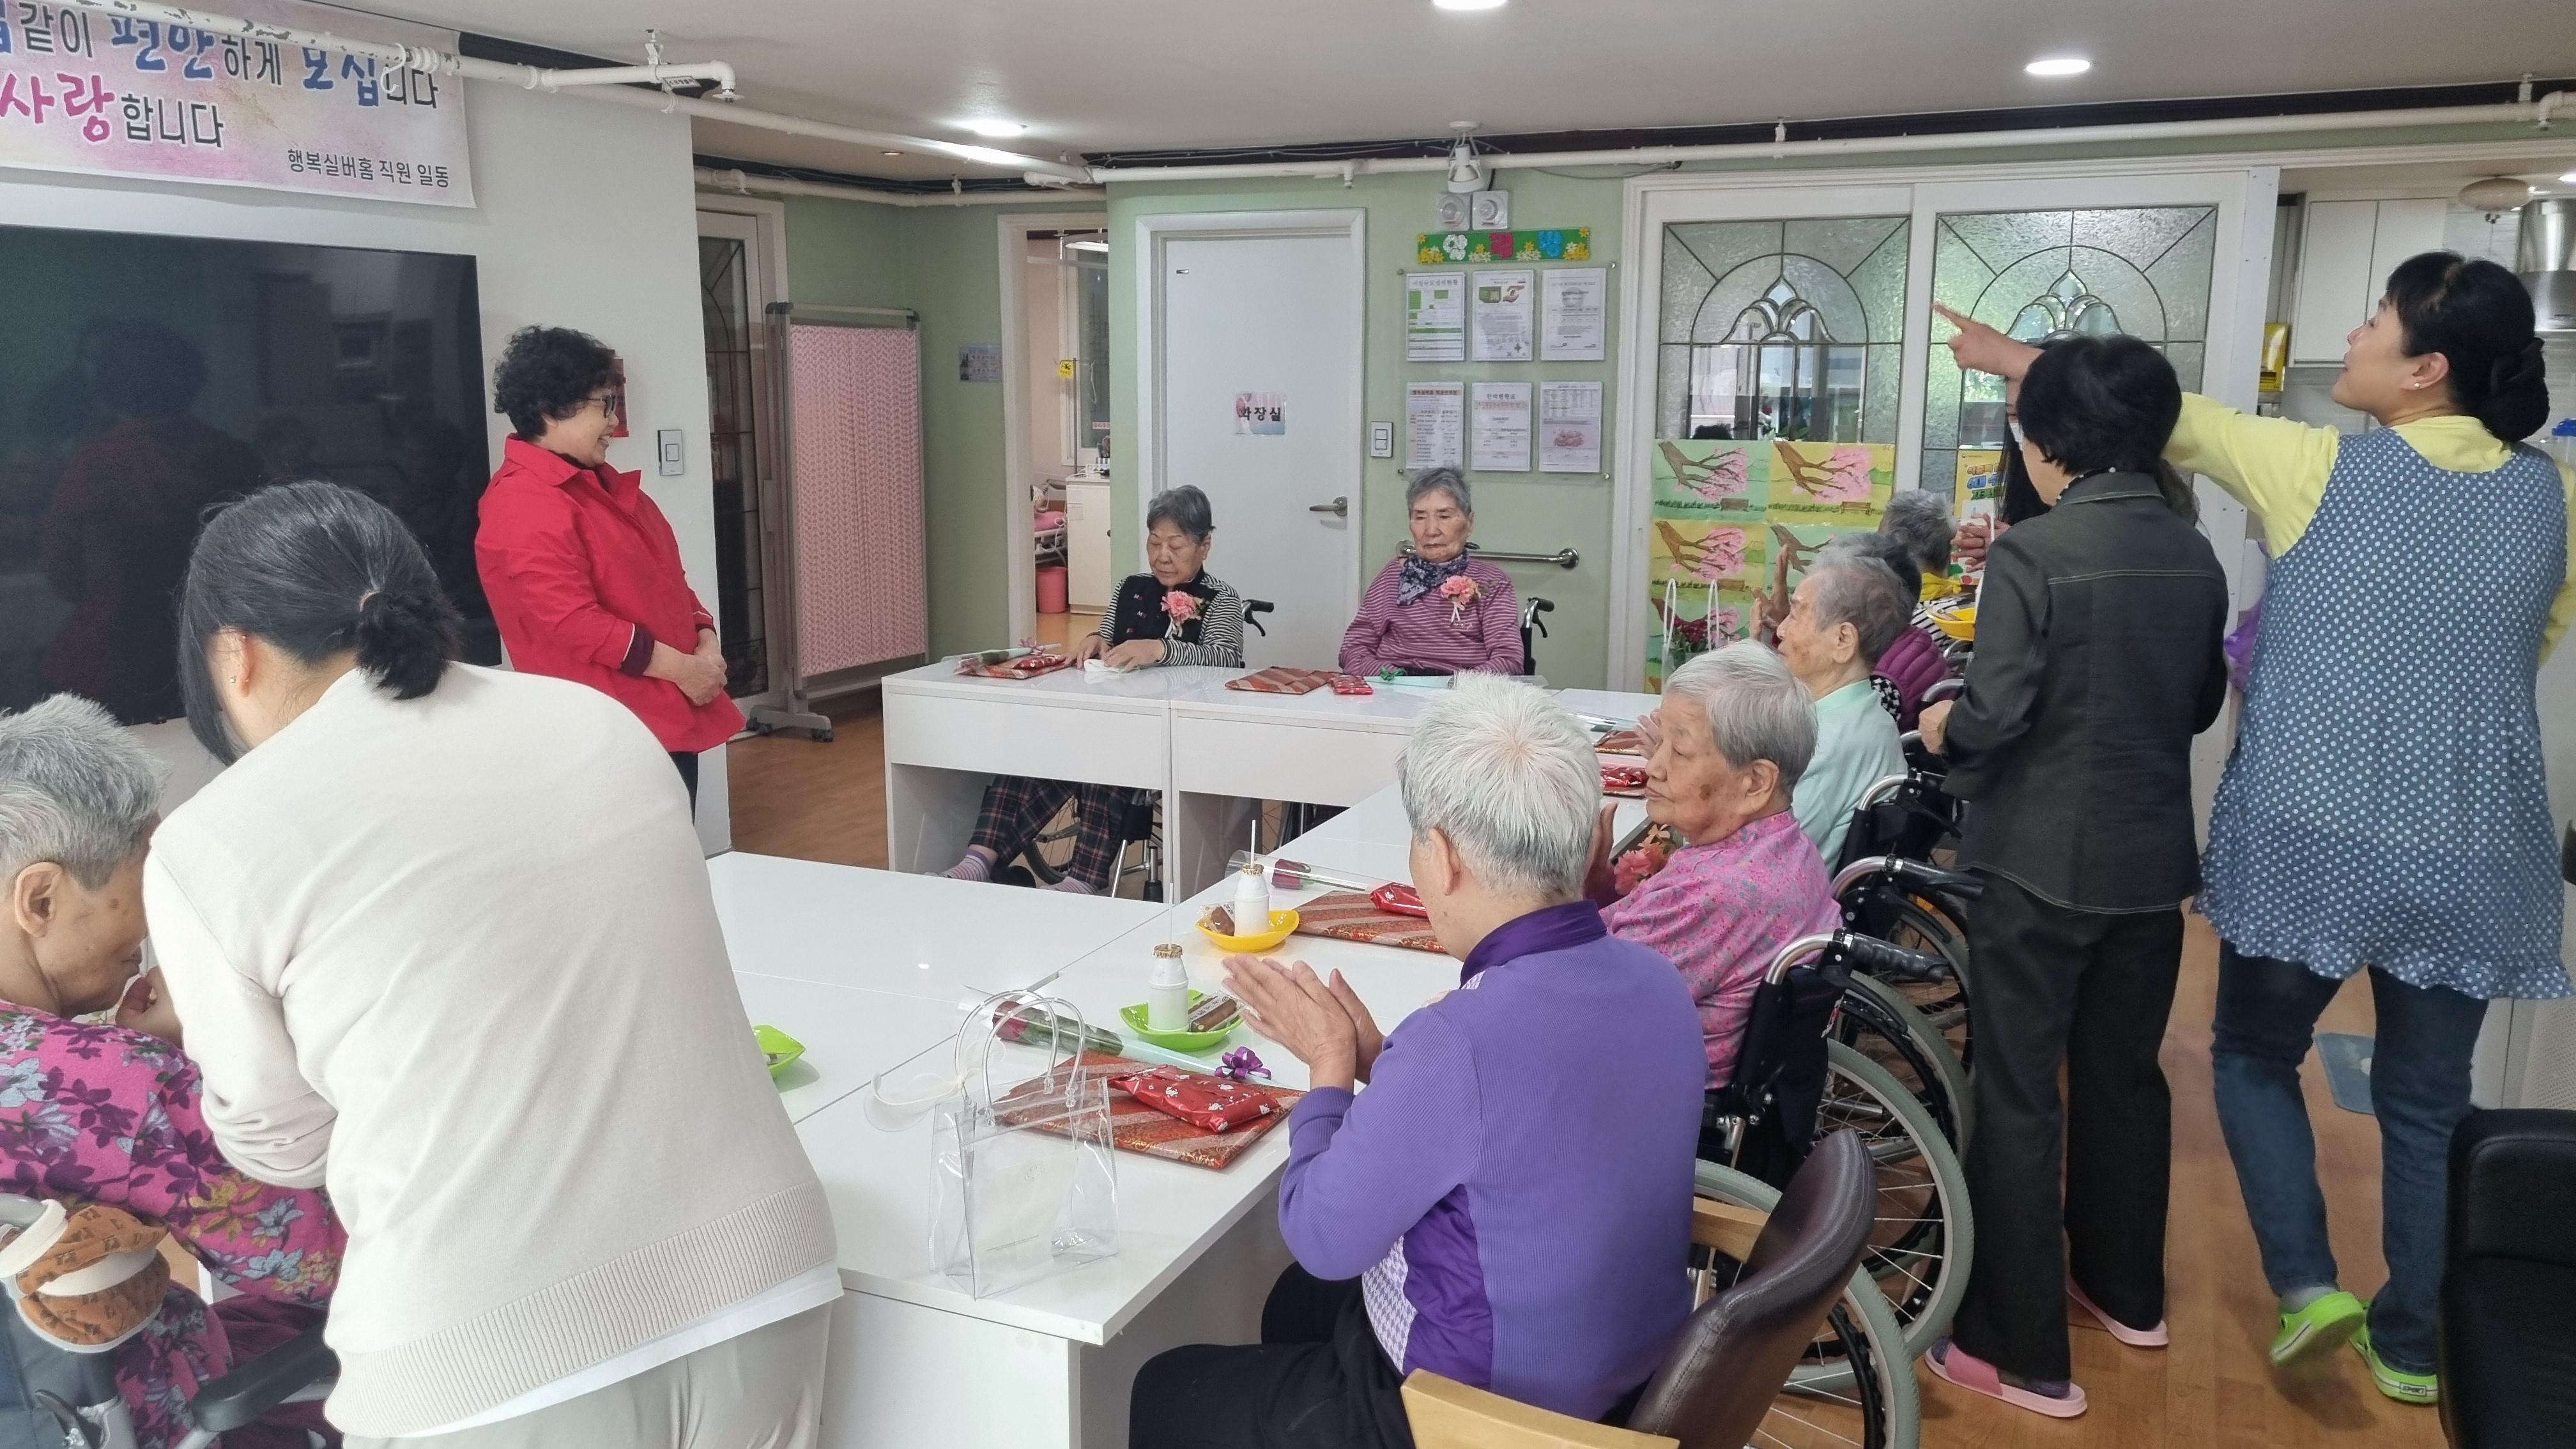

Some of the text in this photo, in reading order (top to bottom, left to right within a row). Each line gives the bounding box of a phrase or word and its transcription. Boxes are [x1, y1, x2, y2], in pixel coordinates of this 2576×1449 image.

[111, 15, 281, 86] 편안하게
[0, 73, 224, 148] 사랑합니다
[288, 148, 448, 188] 행복실버홈 직원 일동
